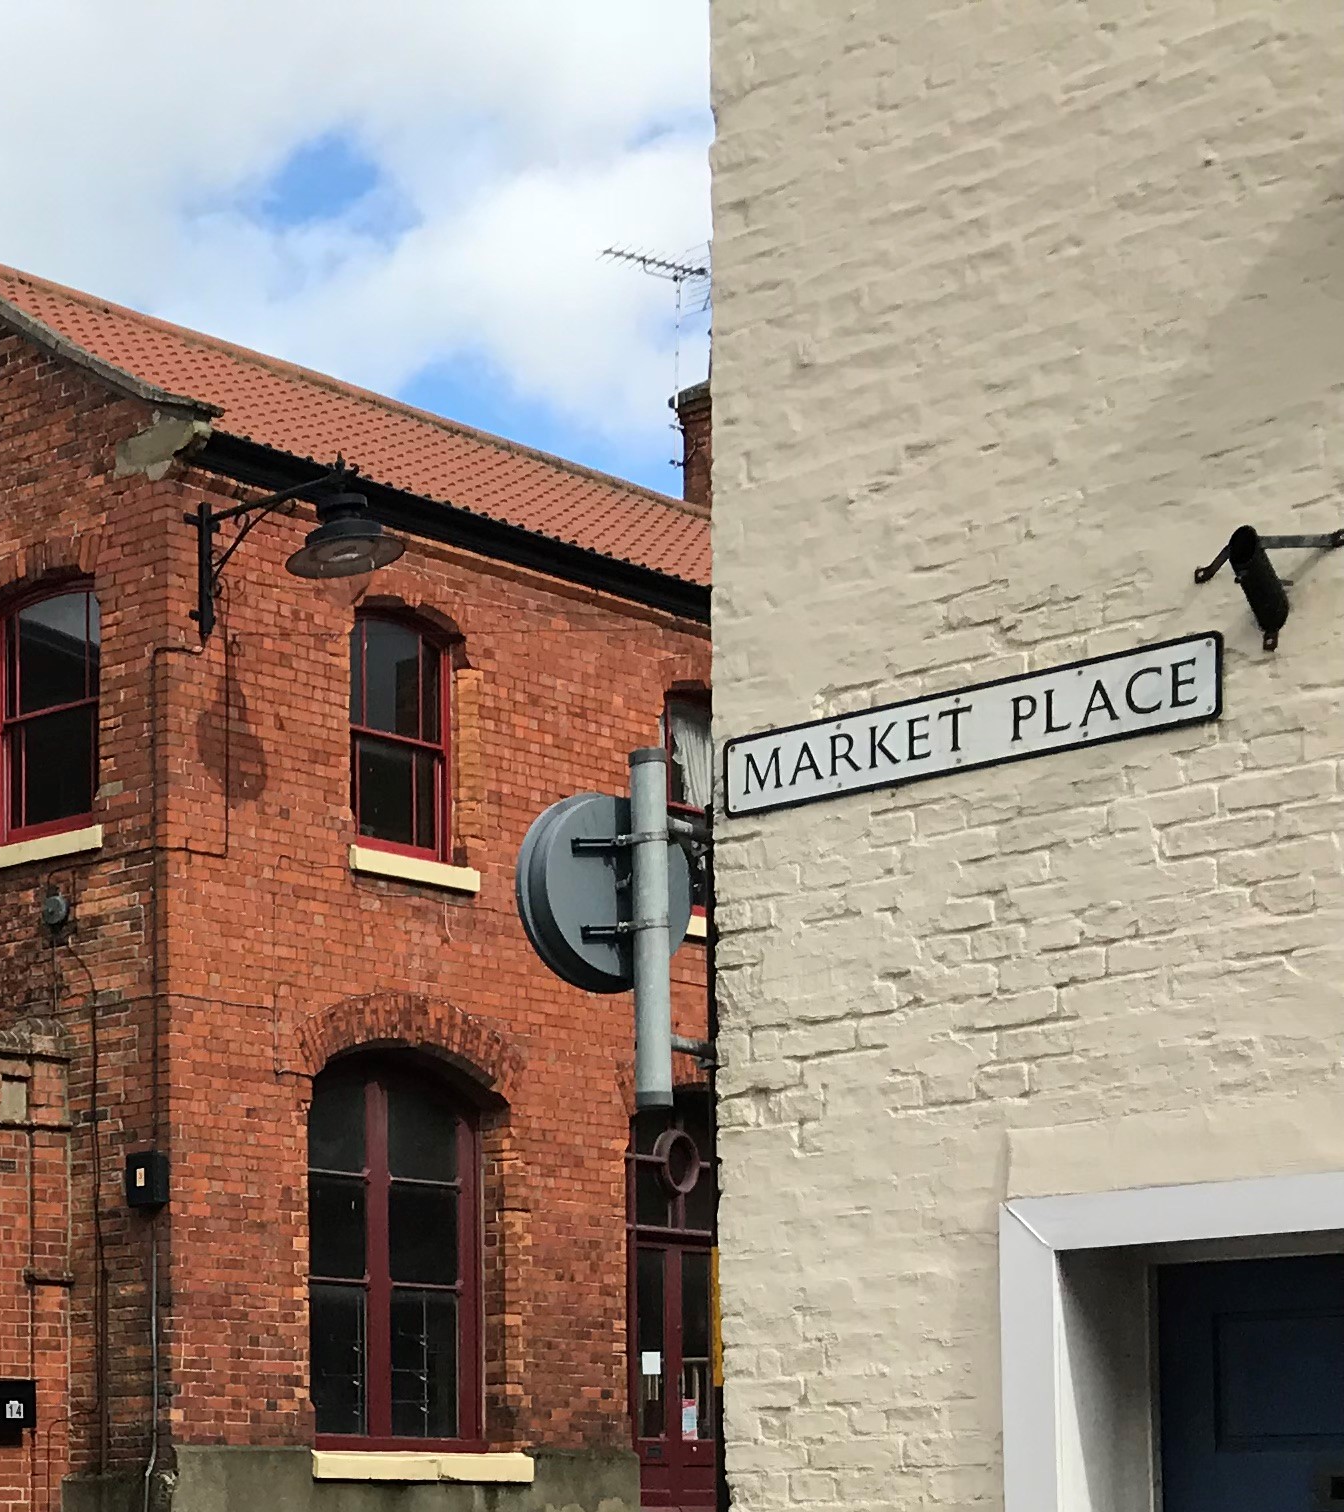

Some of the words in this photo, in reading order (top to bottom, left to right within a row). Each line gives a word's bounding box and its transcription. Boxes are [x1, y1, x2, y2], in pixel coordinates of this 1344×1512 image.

[742, 705, 972, 795] MARKET
[1010, 657, 1199, 742] PLACE
[8, 1404, 22, 1417] 14
